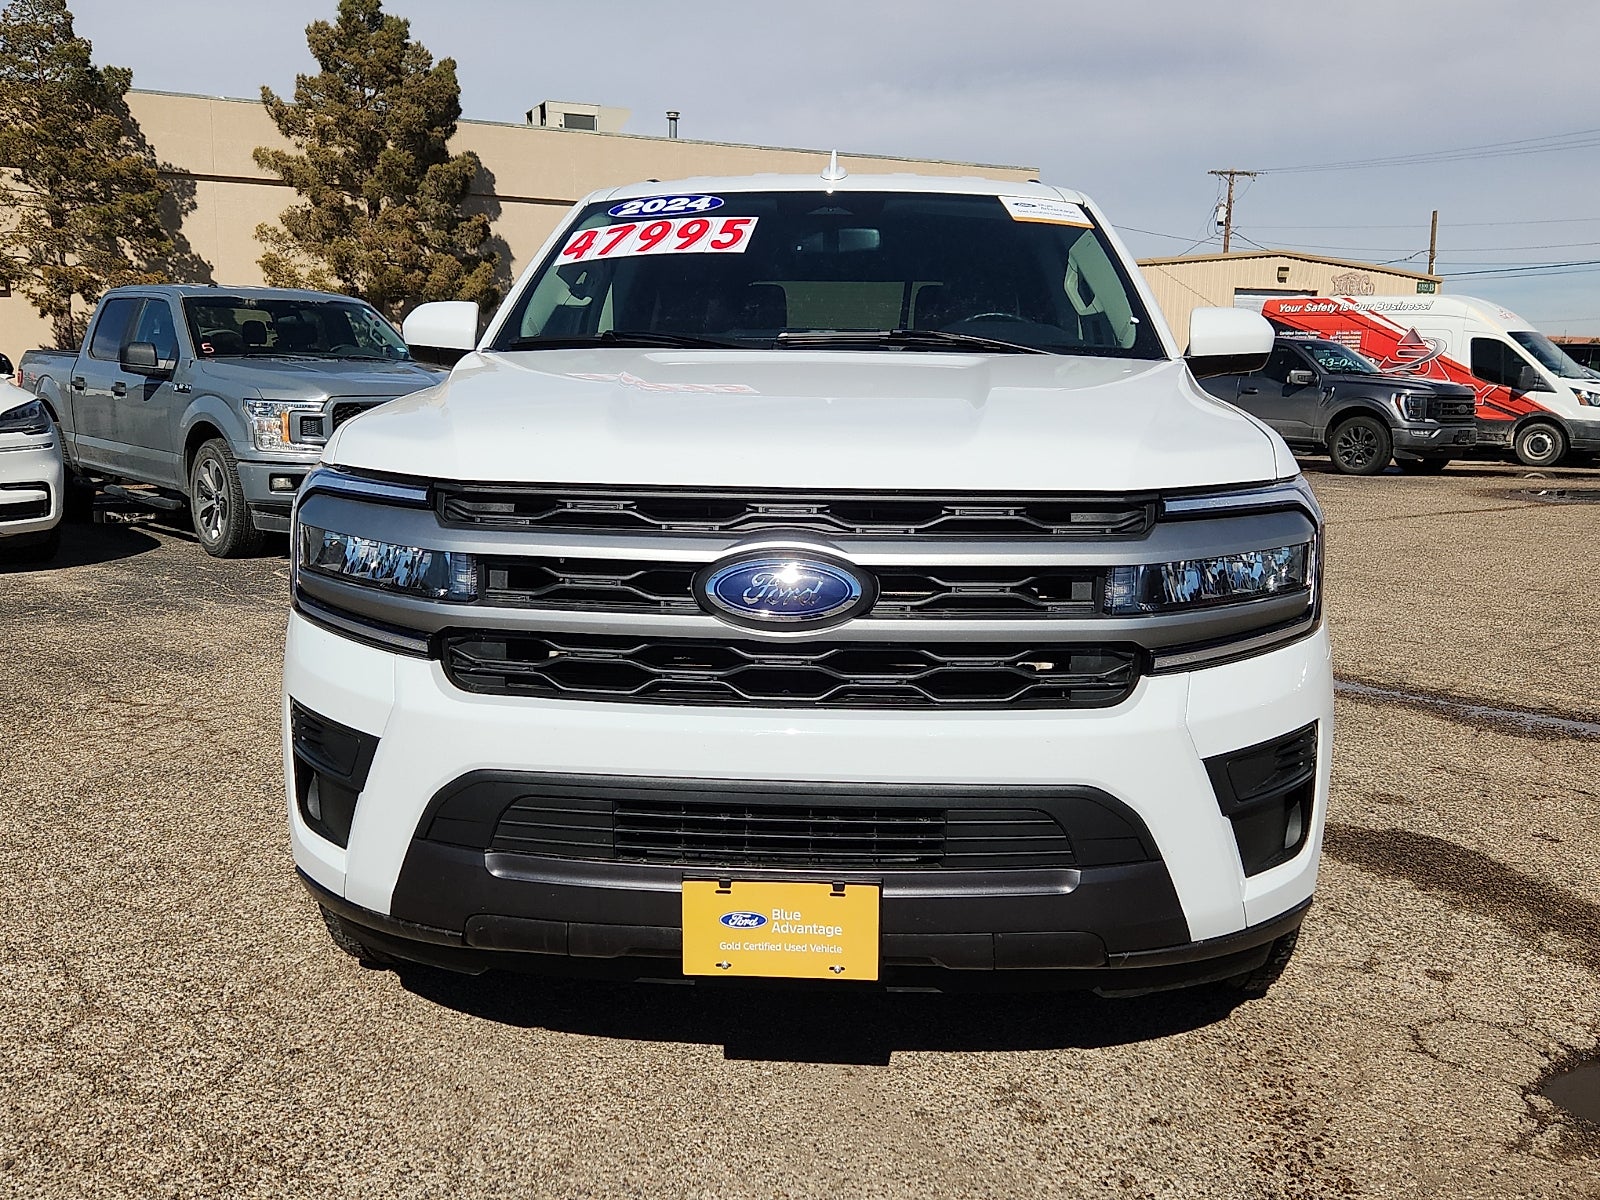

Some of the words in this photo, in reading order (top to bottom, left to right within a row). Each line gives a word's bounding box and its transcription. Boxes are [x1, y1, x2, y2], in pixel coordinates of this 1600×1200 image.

[617, 196, 712, 216] 2024
[562, 218, 753, 260] 47995
[1278, 303, 1303, 313] Your
[1304, 302, 1338, 313] Safety
[1351, 302, 1373, 312] Our
[1375, 300, 1434, 311] Business!
[201, 342, 215, 354] 5
[742, 570, 825, 606] Ford
[728, 913, 759, 927] Ford
[771, 908, 801, 920] Blue
[771, 921, 843, 938] Advantage
[719, 941, 741, 951] Gold
[743, 942, 782, 952] Certified
[783, 943, 807, 952] Used
[809, 943, 843, 954] Vehicle
